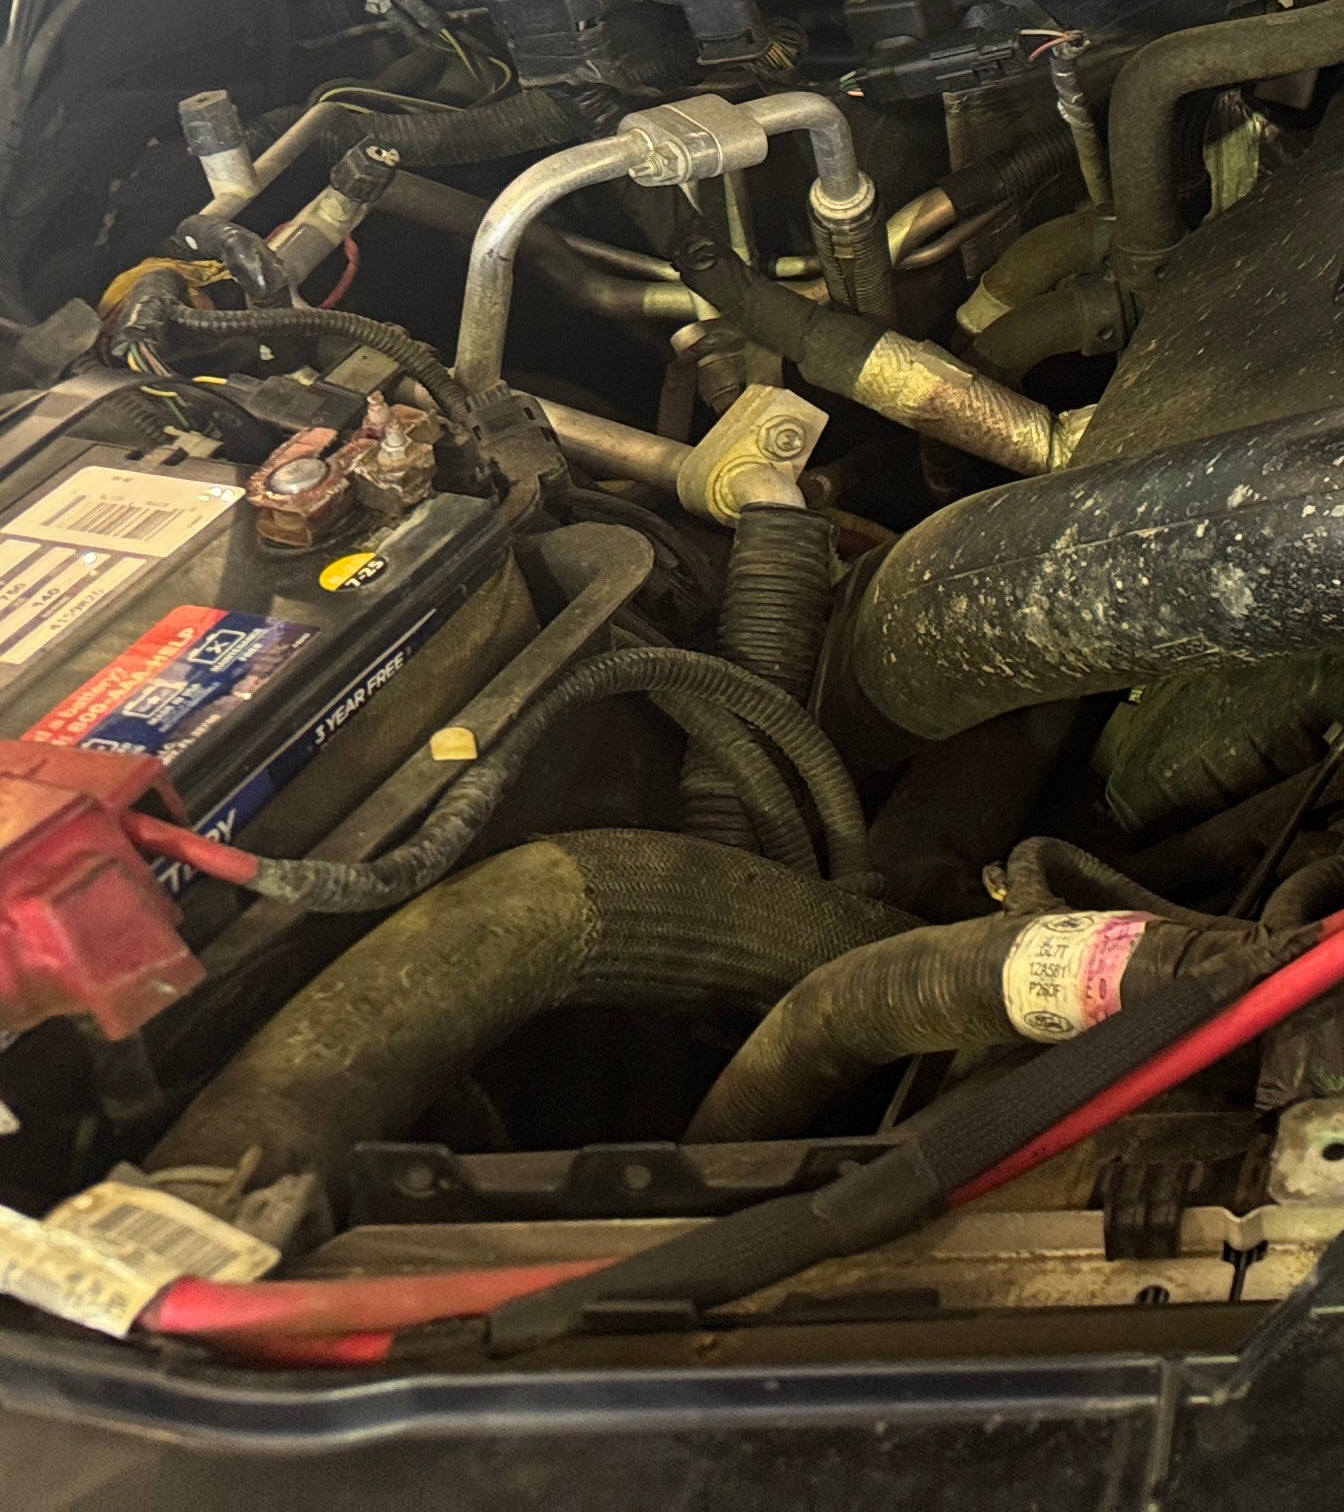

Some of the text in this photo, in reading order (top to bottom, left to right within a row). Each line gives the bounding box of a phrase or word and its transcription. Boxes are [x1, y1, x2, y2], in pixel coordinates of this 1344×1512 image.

[345, 559, 385, 588] 7-25
[314, 650, 406, 745] 3 YEAR FREE
